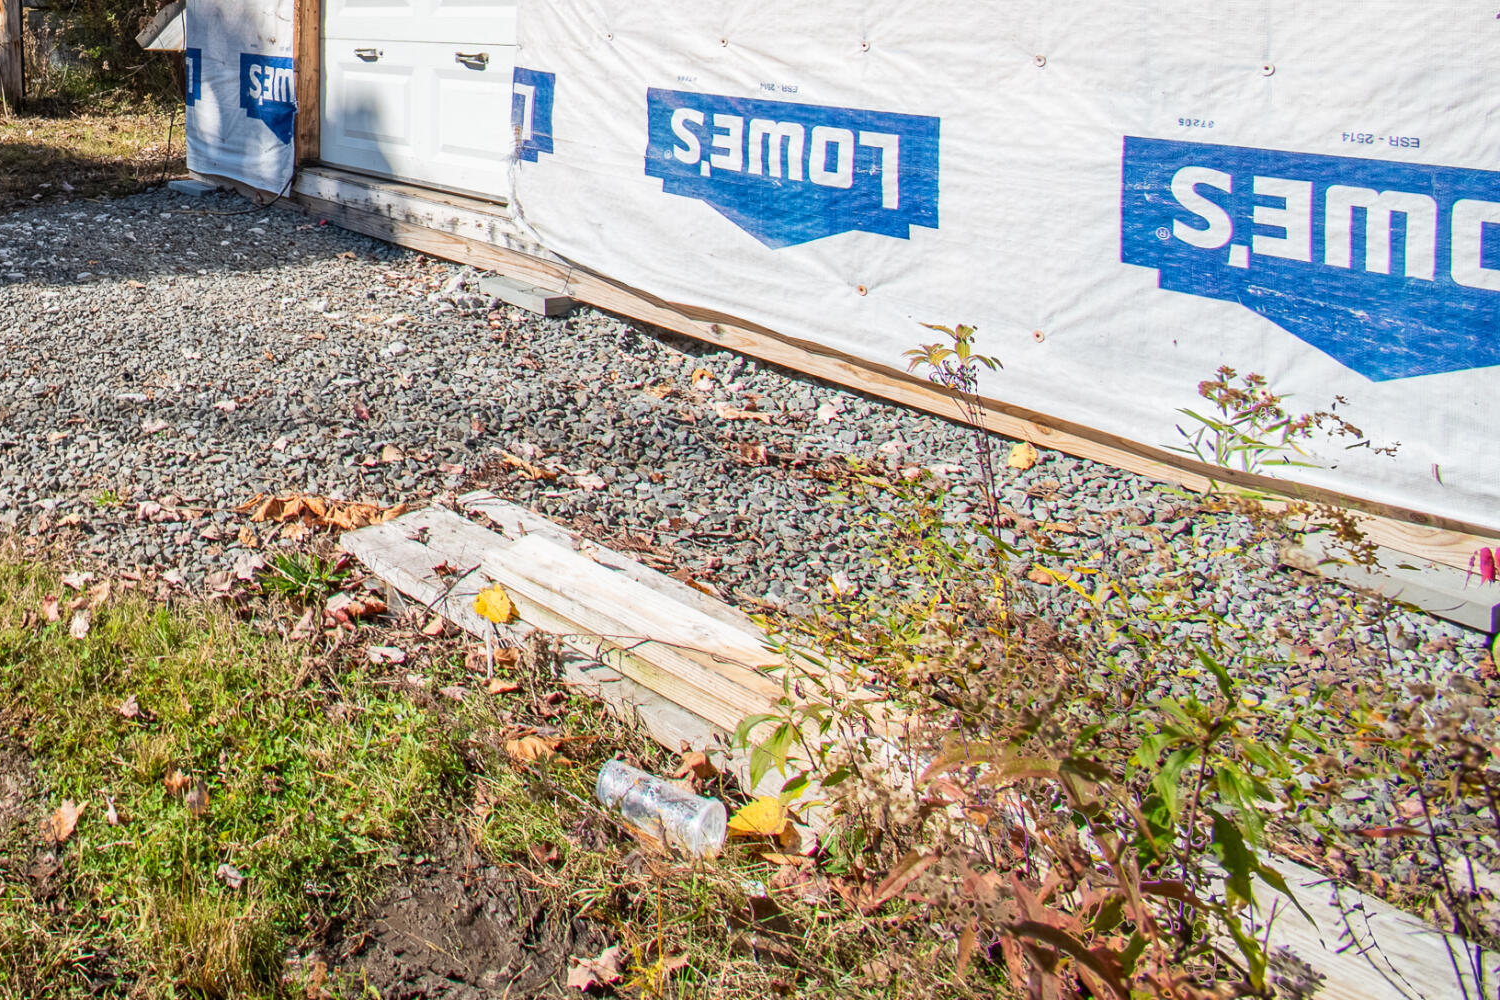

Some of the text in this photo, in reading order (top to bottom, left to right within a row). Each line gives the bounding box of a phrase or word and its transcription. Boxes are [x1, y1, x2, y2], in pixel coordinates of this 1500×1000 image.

[249, 63, 295, 106] WE'S
[1177, 116, 1215, 129] 37205
[1341, 130, 1374, 145] 2514
[1387, 135, 1421, 149] ESR
[670, 106, 900, 211] LOWE'S
